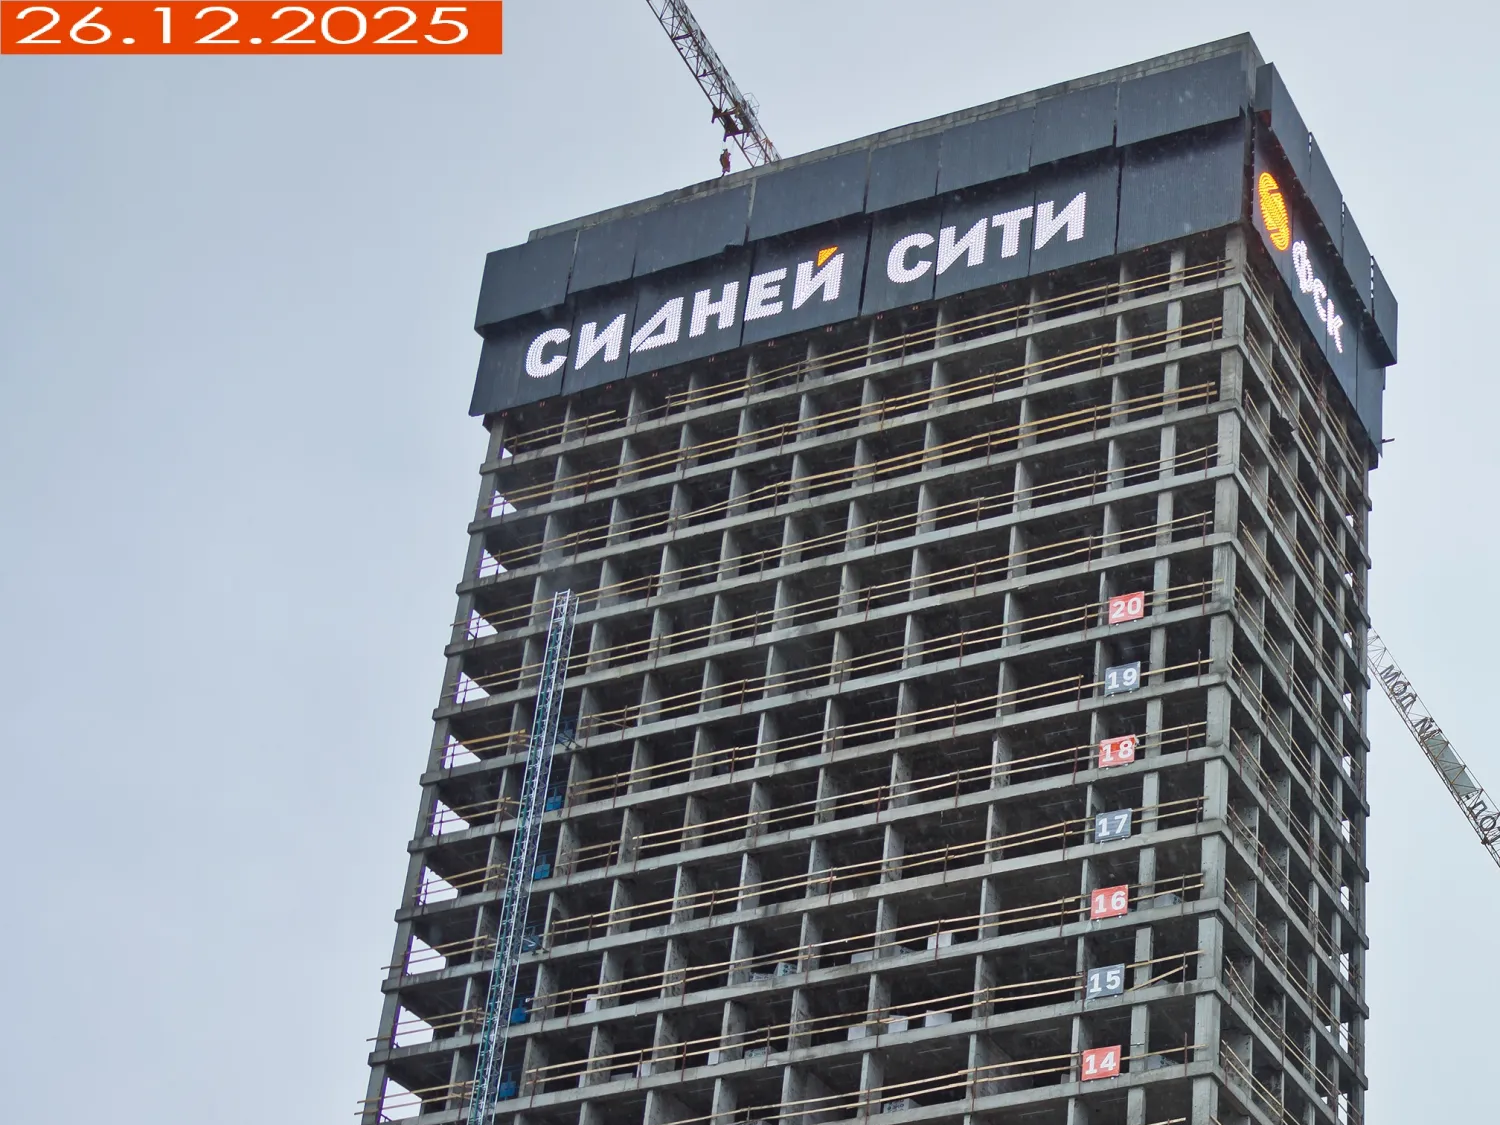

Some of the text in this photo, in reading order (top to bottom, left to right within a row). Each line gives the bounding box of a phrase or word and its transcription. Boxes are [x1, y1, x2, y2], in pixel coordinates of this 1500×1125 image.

[525, 192, 1086, 380] СИДНЕЙ СИТИ
[1292, 241, 1343, 354] ФСК
[1112, 597, 1144, 619] 20
[1107, 667, 1138, 688] 19
[1102, 740, 1134, 762] 18
[1098, 816, 1129, 838] 17
[1095, 891, 1127, 912] 16
[1090, 969, 1121, 992] 15
[1086, 1052, 1117, 1075] 14
